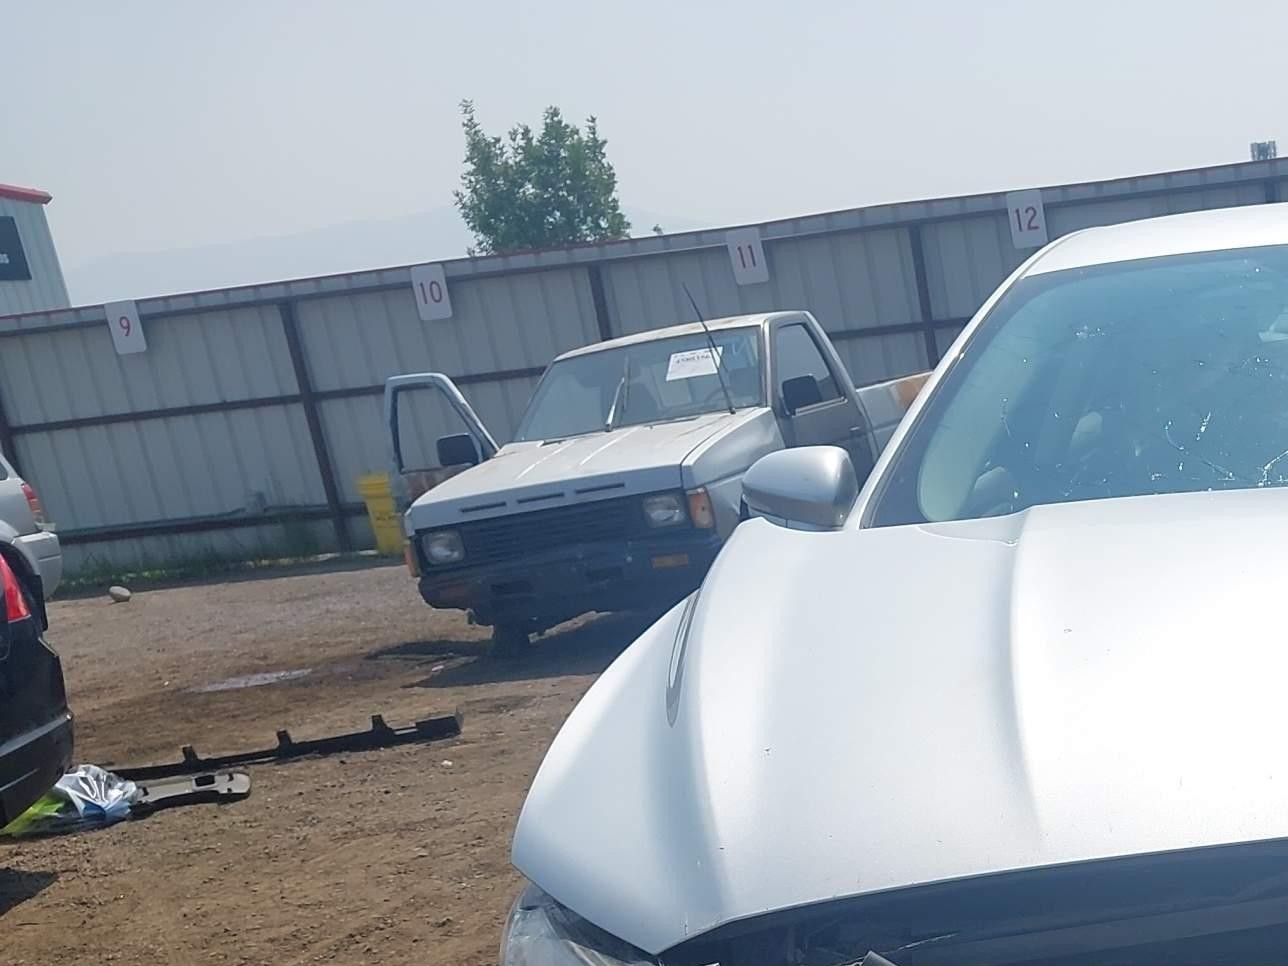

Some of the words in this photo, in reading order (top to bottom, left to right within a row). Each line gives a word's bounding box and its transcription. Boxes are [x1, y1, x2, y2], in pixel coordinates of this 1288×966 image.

[1014, 207, 1039, 232] 12
[736, 244, 757, 268] 11
[419, 280, 443, 304] 10
[119, 316, 132, 336] 9
